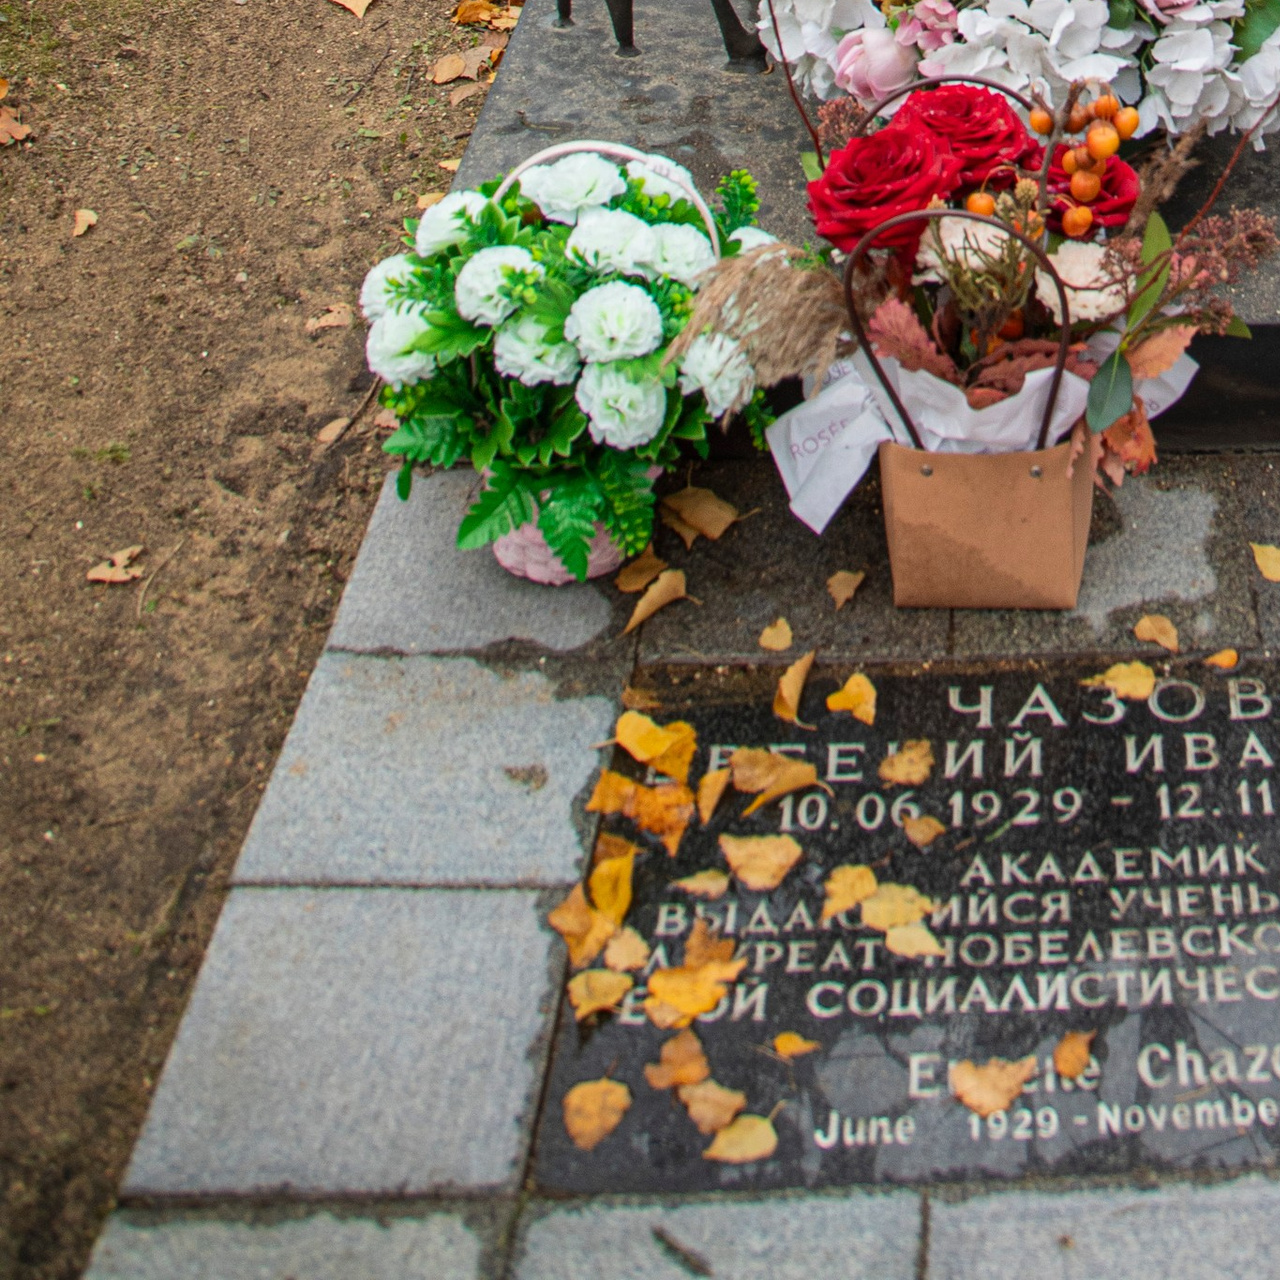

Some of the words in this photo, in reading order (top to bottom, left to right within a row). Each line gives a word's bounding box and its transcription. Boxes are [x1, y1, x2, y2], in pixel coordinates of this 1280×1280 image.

[949, 678, 1272, 729] ЧАЗОВ
[959, 843, 1267, 887] АКАДЕМИК
[814, 1110, 916, 1146] June
[967, 1104, 1058, 1140] 1929
